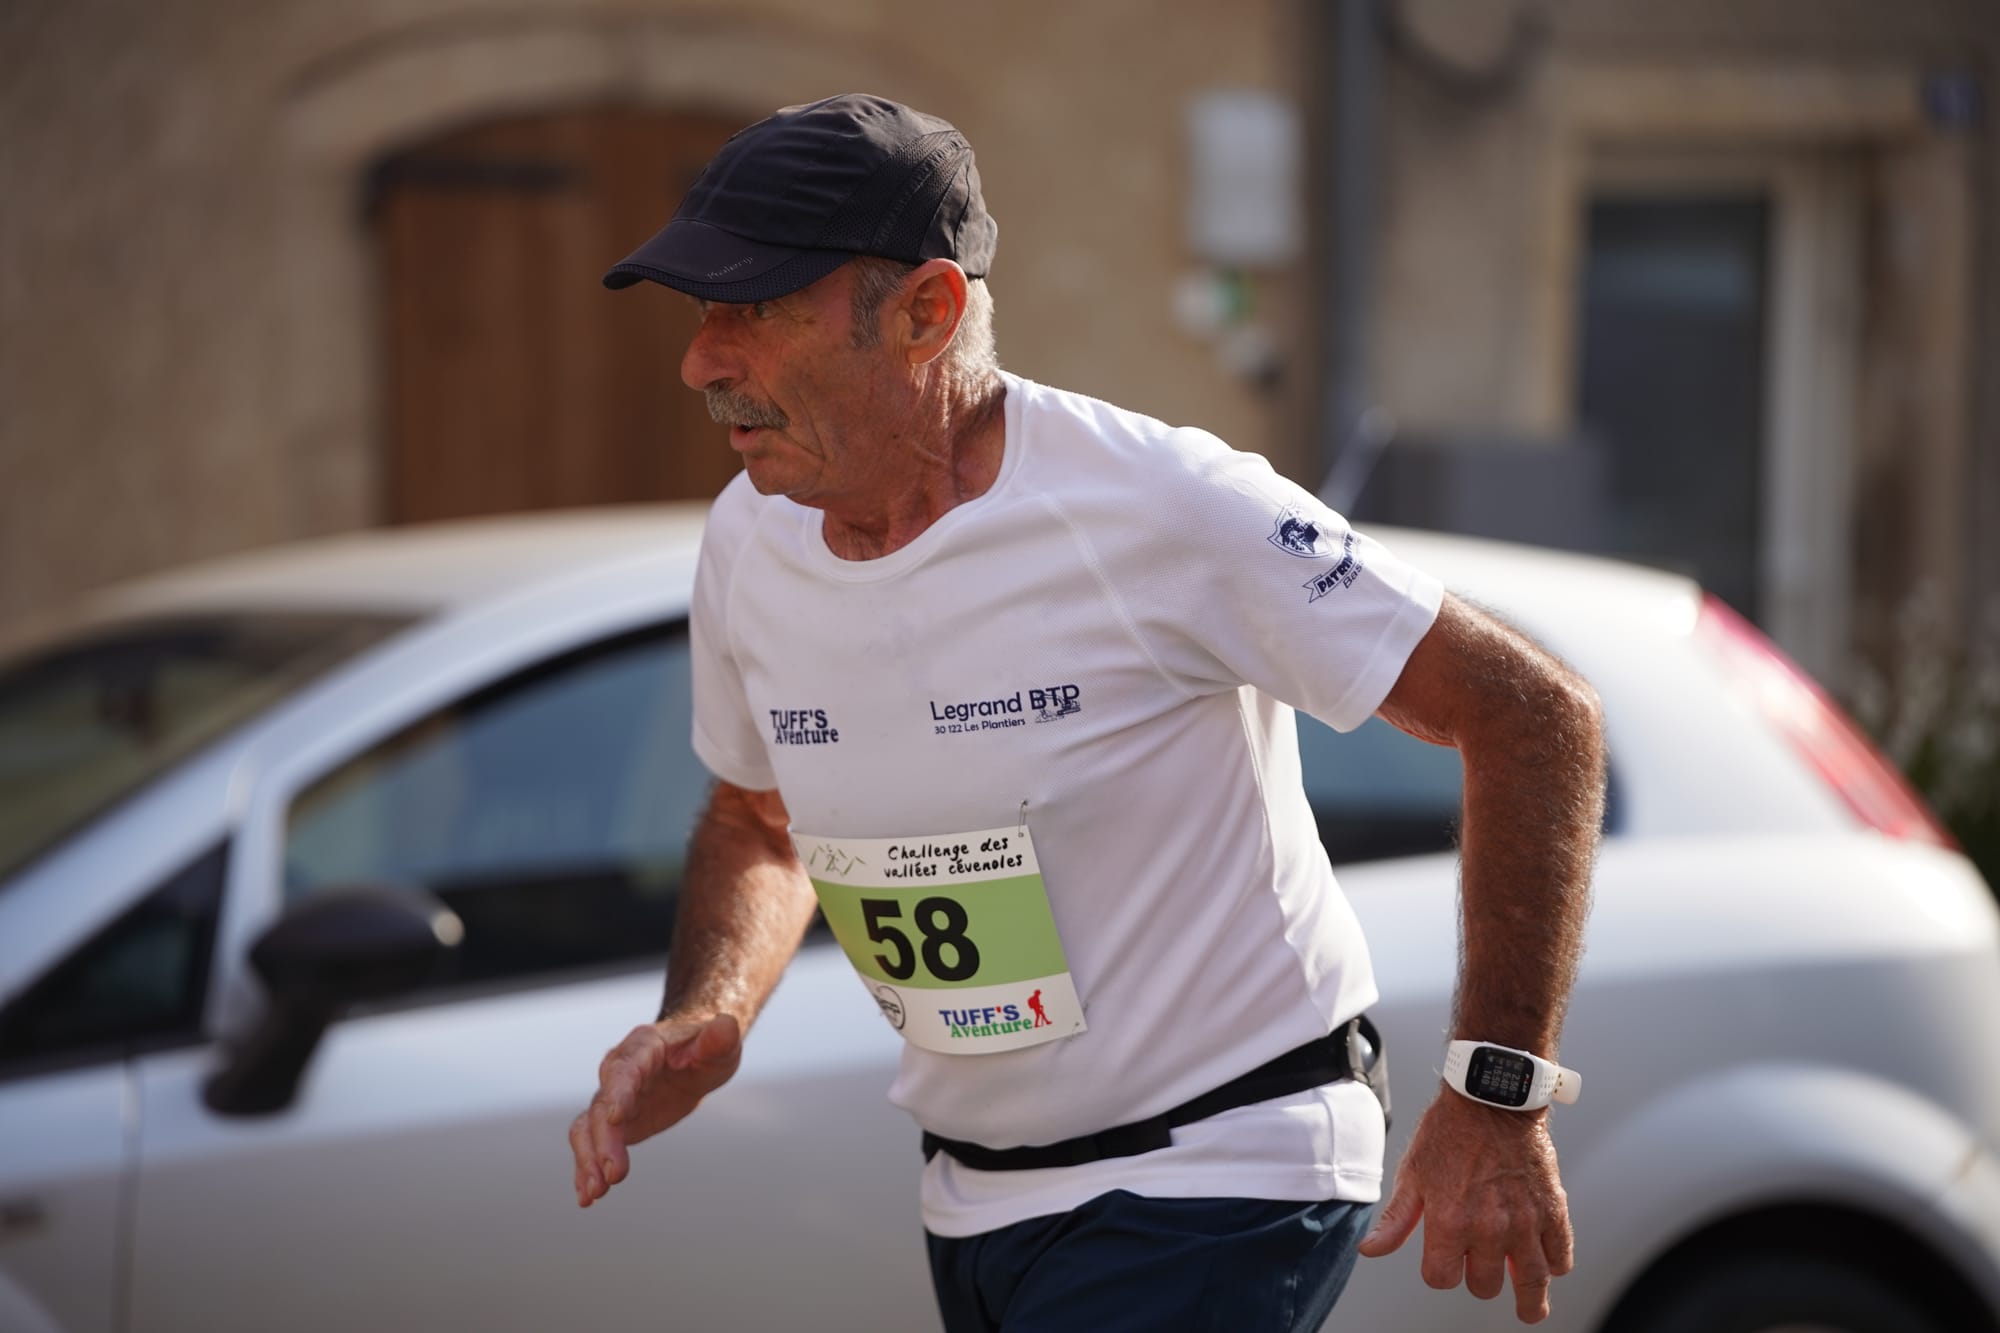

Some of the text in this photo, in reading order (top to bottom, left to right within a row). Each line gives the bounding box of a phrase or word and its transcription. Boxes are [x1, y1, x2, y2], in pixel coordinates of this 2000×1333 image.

[930, 684, 1080, 721] Legrand BTP
[770, 709, 829, 729] TUFF'S
[934, 718, 1027, 735] 30 122 Les Plantiers
[775, 727, 839, 745] Aventure
[887, 837, 1009, 863] Challenge des
[883, 853, 1023, 878] vallées cévenoles
[860, 896, 981, 982] 58
[938, 1004, 1021, 1026] TUFF'S
[950, 1016, 1033, 1039] Aventure
